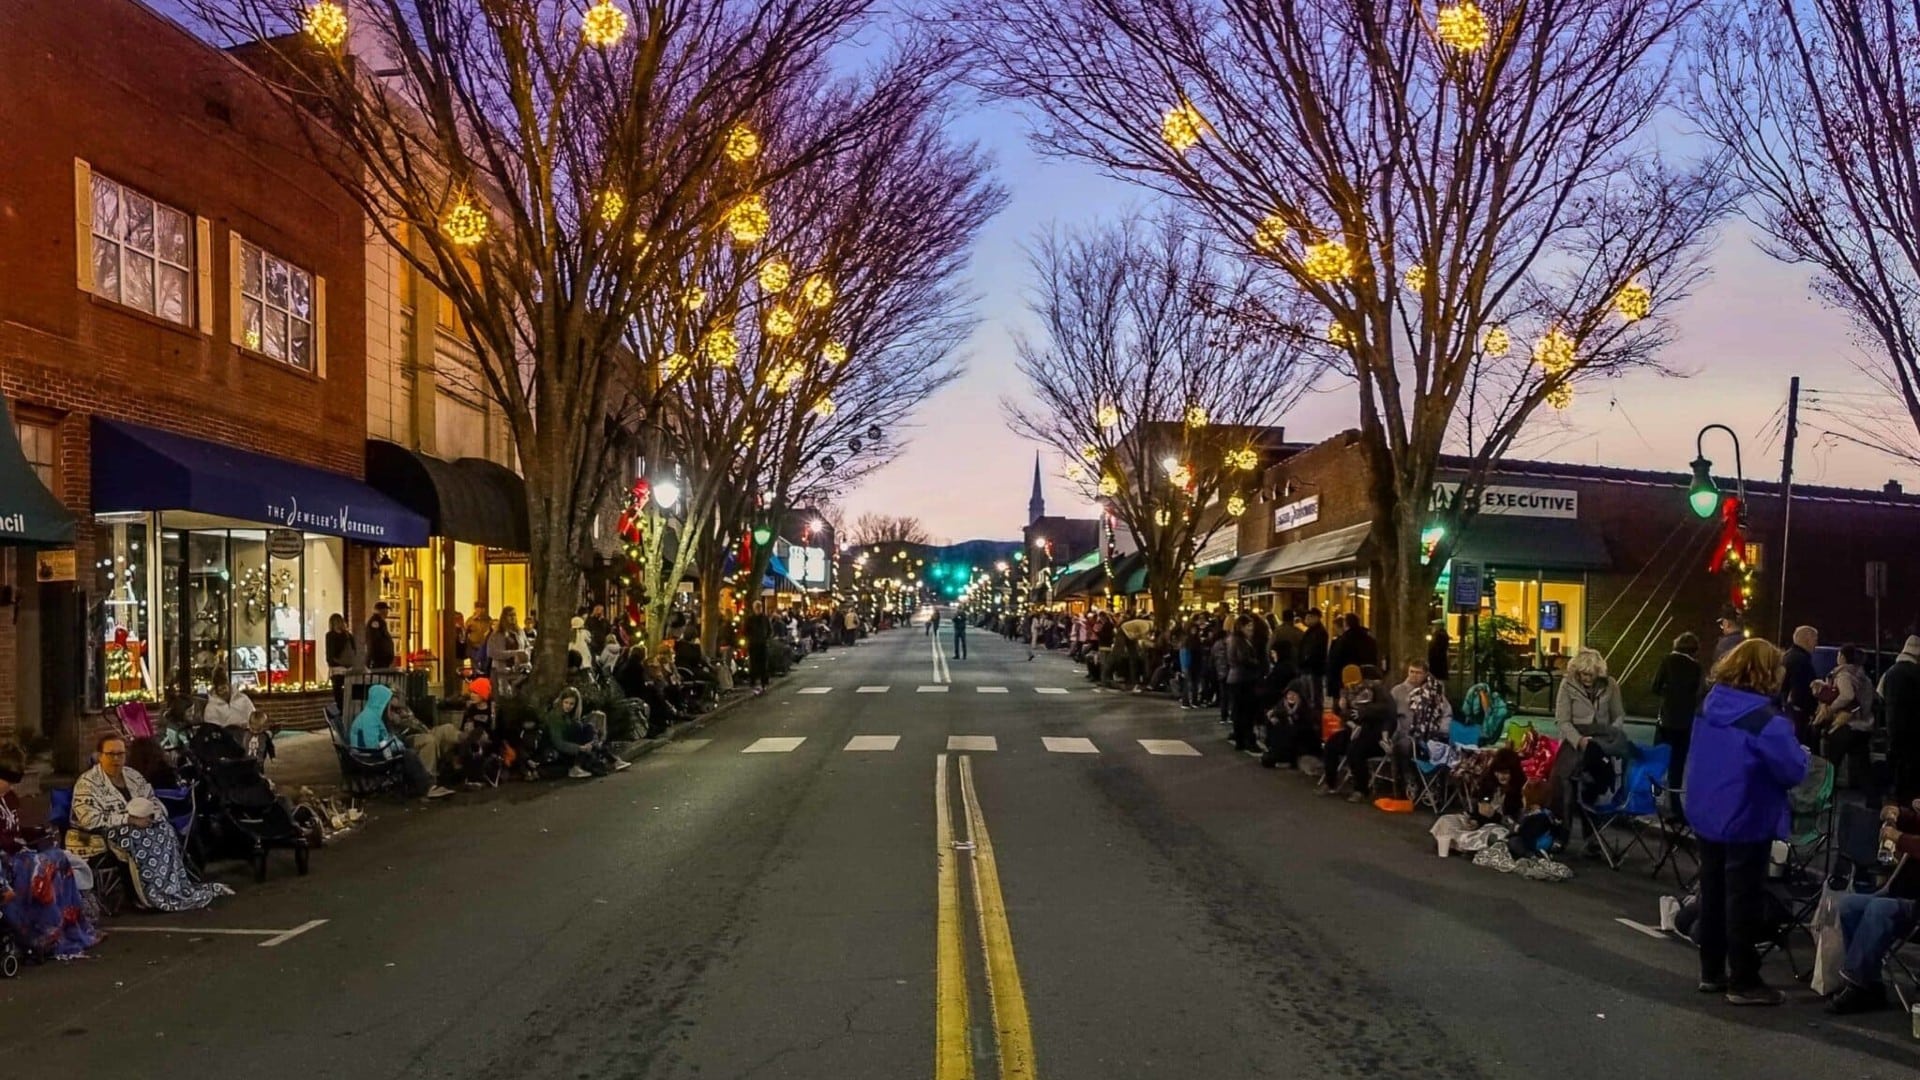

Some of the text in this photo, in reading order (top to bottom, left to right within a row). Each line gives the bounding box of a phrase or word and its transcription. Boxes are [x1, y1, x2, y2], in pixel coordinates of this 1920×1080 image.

[267, 495, 385, 535] THE JEWELER'S WORKBENCH
[1485, 492, 1575, 511] EXECUTIVE
